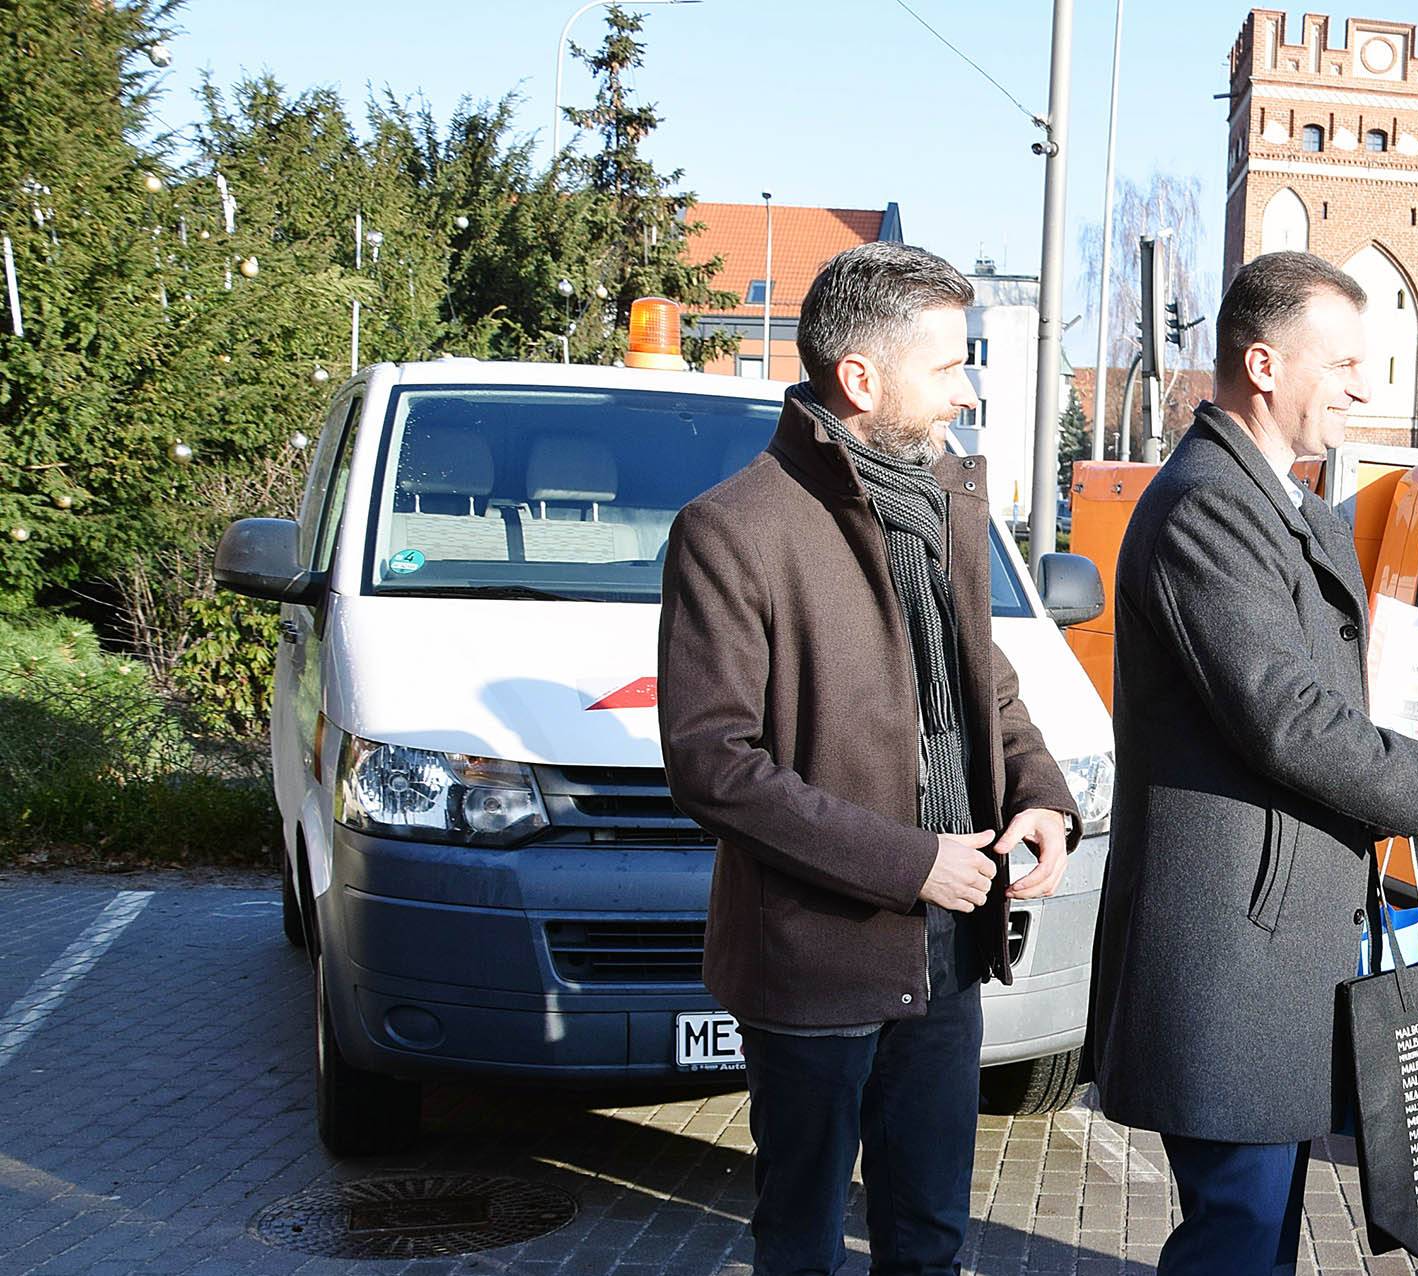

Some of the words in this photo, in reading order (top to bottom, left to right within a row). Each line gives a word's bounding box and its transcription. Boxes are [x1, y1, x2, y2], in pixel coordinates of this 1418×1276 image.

[404, 552, 415, 562] 4
[685, 1020, 736, 1057] ME
[719, 1063, 747, 1071] Auto
